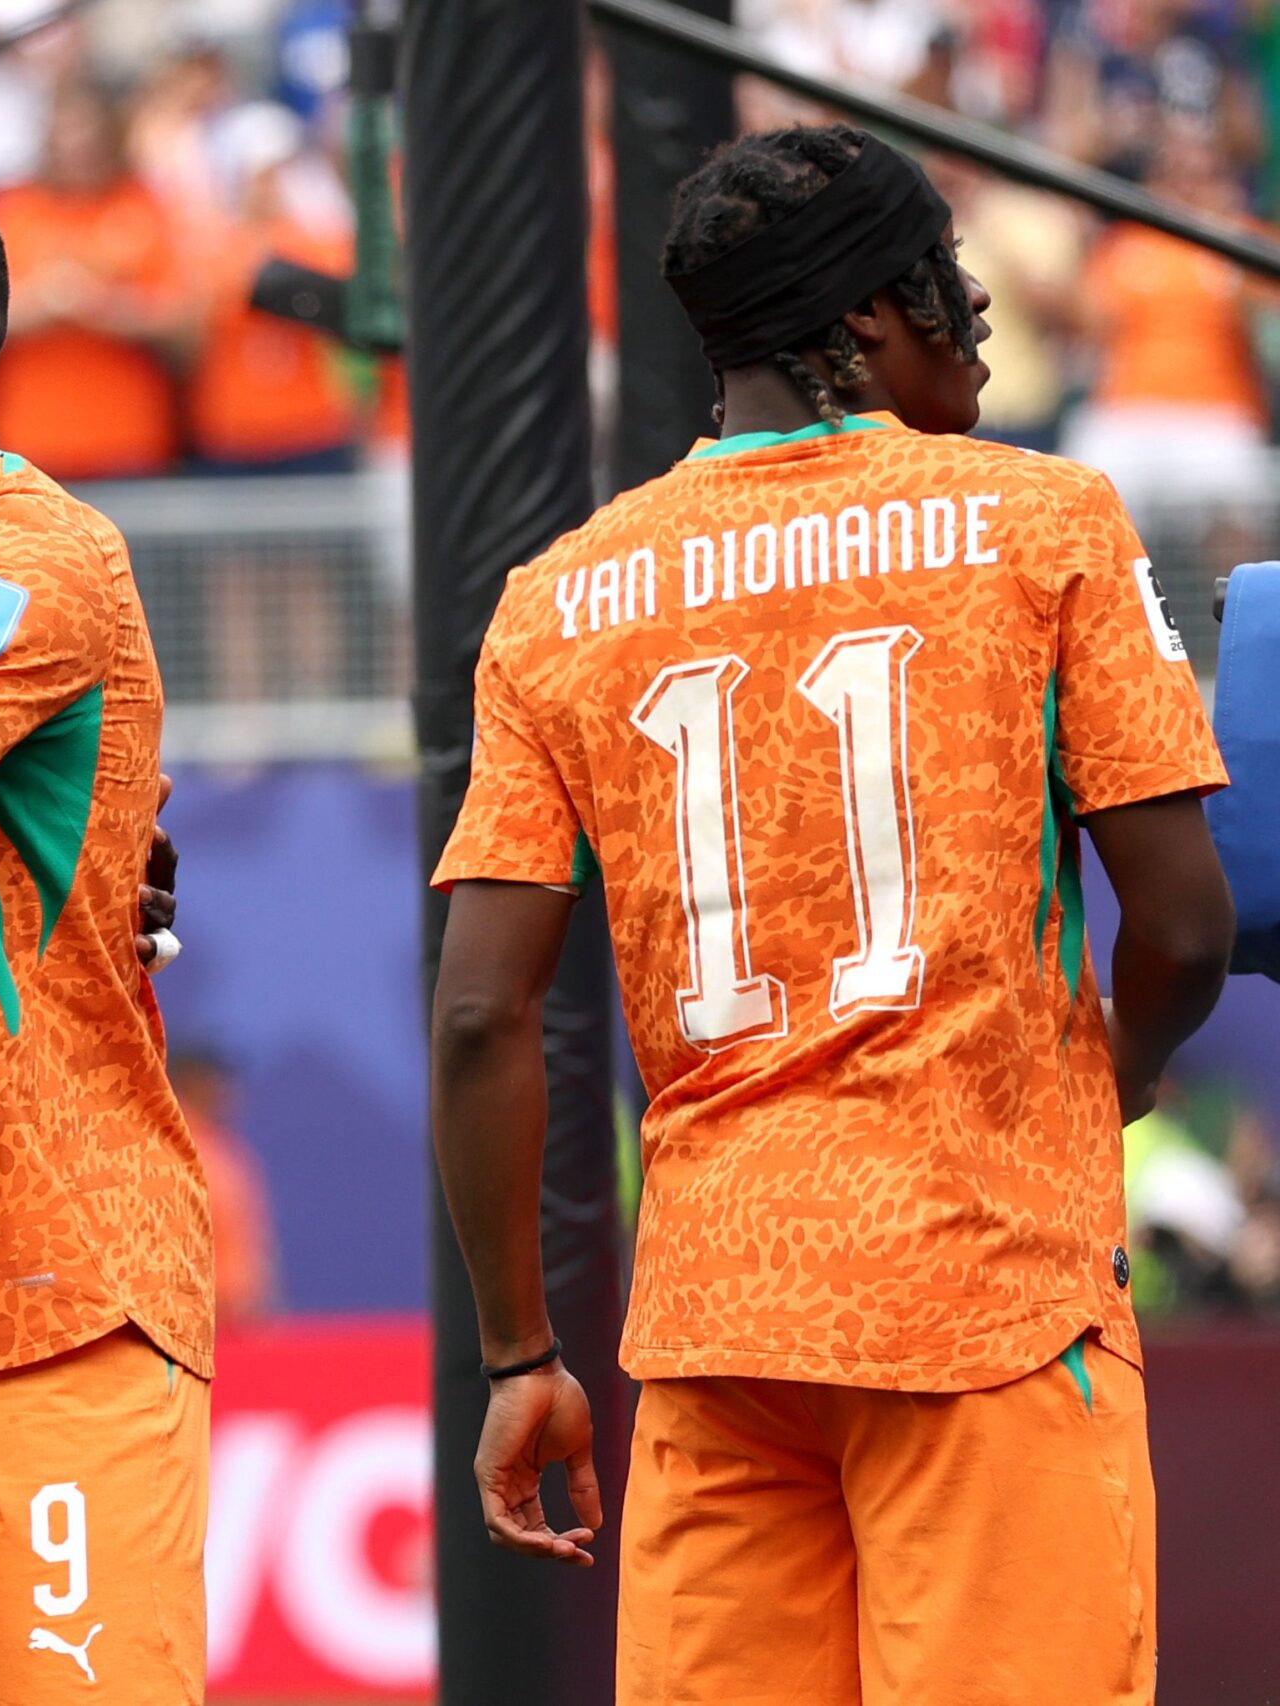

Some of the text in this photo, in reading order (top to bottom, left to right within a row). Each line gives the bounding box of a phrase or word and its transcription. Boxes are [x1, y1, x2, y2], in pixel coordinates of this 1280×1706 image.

[555, 495, 1001, 639] YAN DIOMANDE
[629, 624, 925, 1054] 11
[30, 1481, 88, 1616] 9
